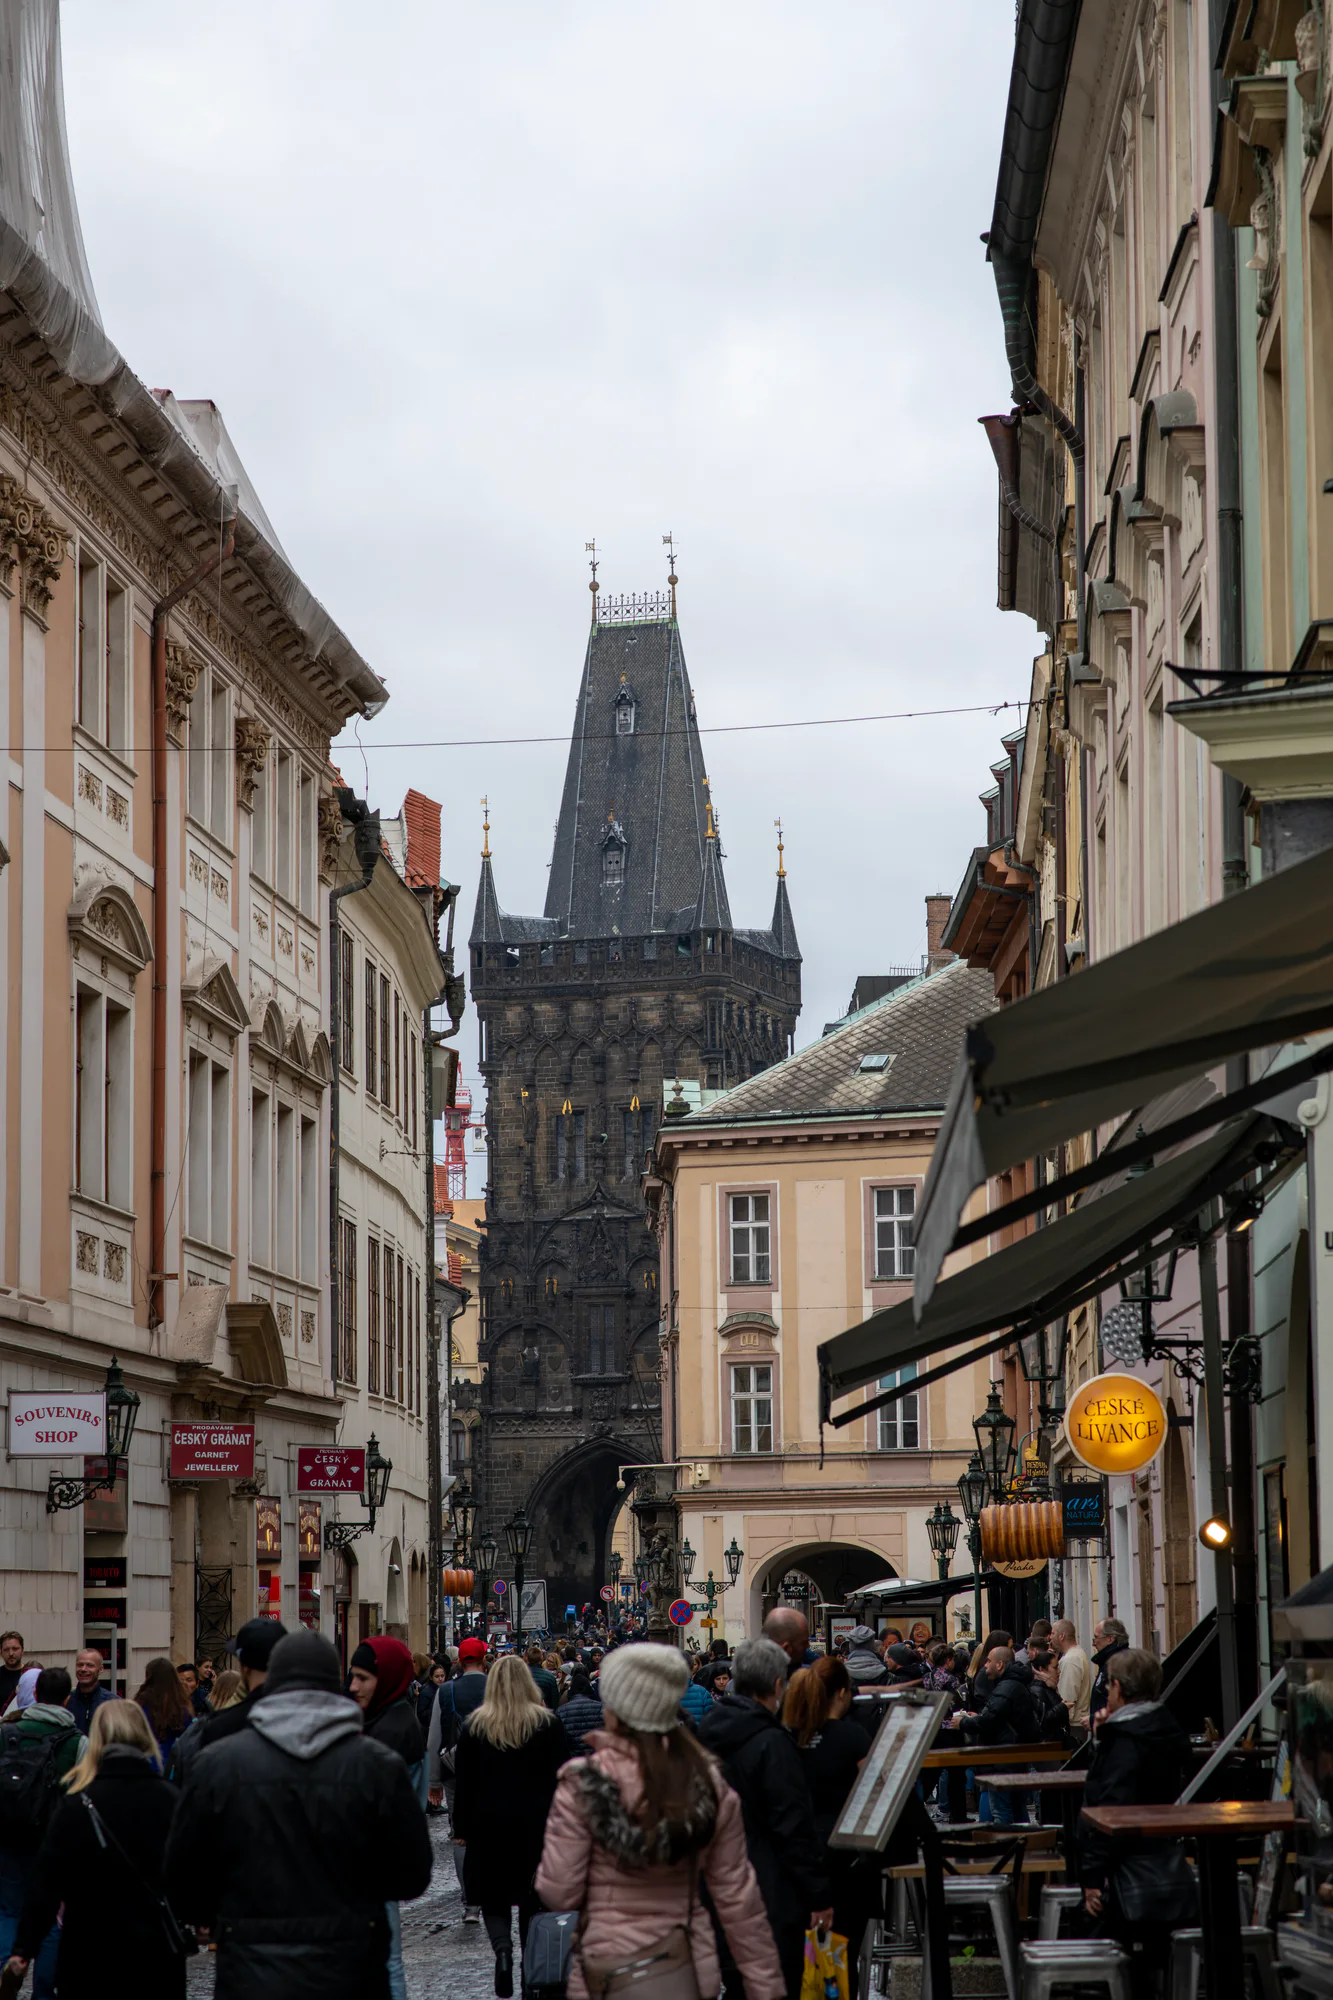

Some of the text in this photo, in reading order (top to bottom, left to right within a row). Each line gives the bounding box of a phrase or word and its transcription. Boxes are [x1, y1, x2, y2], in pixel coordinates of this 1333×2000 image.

[1084, 1398, 1145, 1416] ČESKÉ
[14, 1406, 101, 1427] SOUVENIRS
[35, 1431, 78, 1443] SHOP
[174, 1430, 208, 1445] ČESKÝ
[1076, 1418, 1159, 1443] LÍVANCE
[314, 1454, 349, 1464] ČESKÝ
[309, 1478, 353, 1488] GRANÁT
[1066, 1493, 1100, 1510] ars
[1066, 1511, 1100, 1519] NATURA
